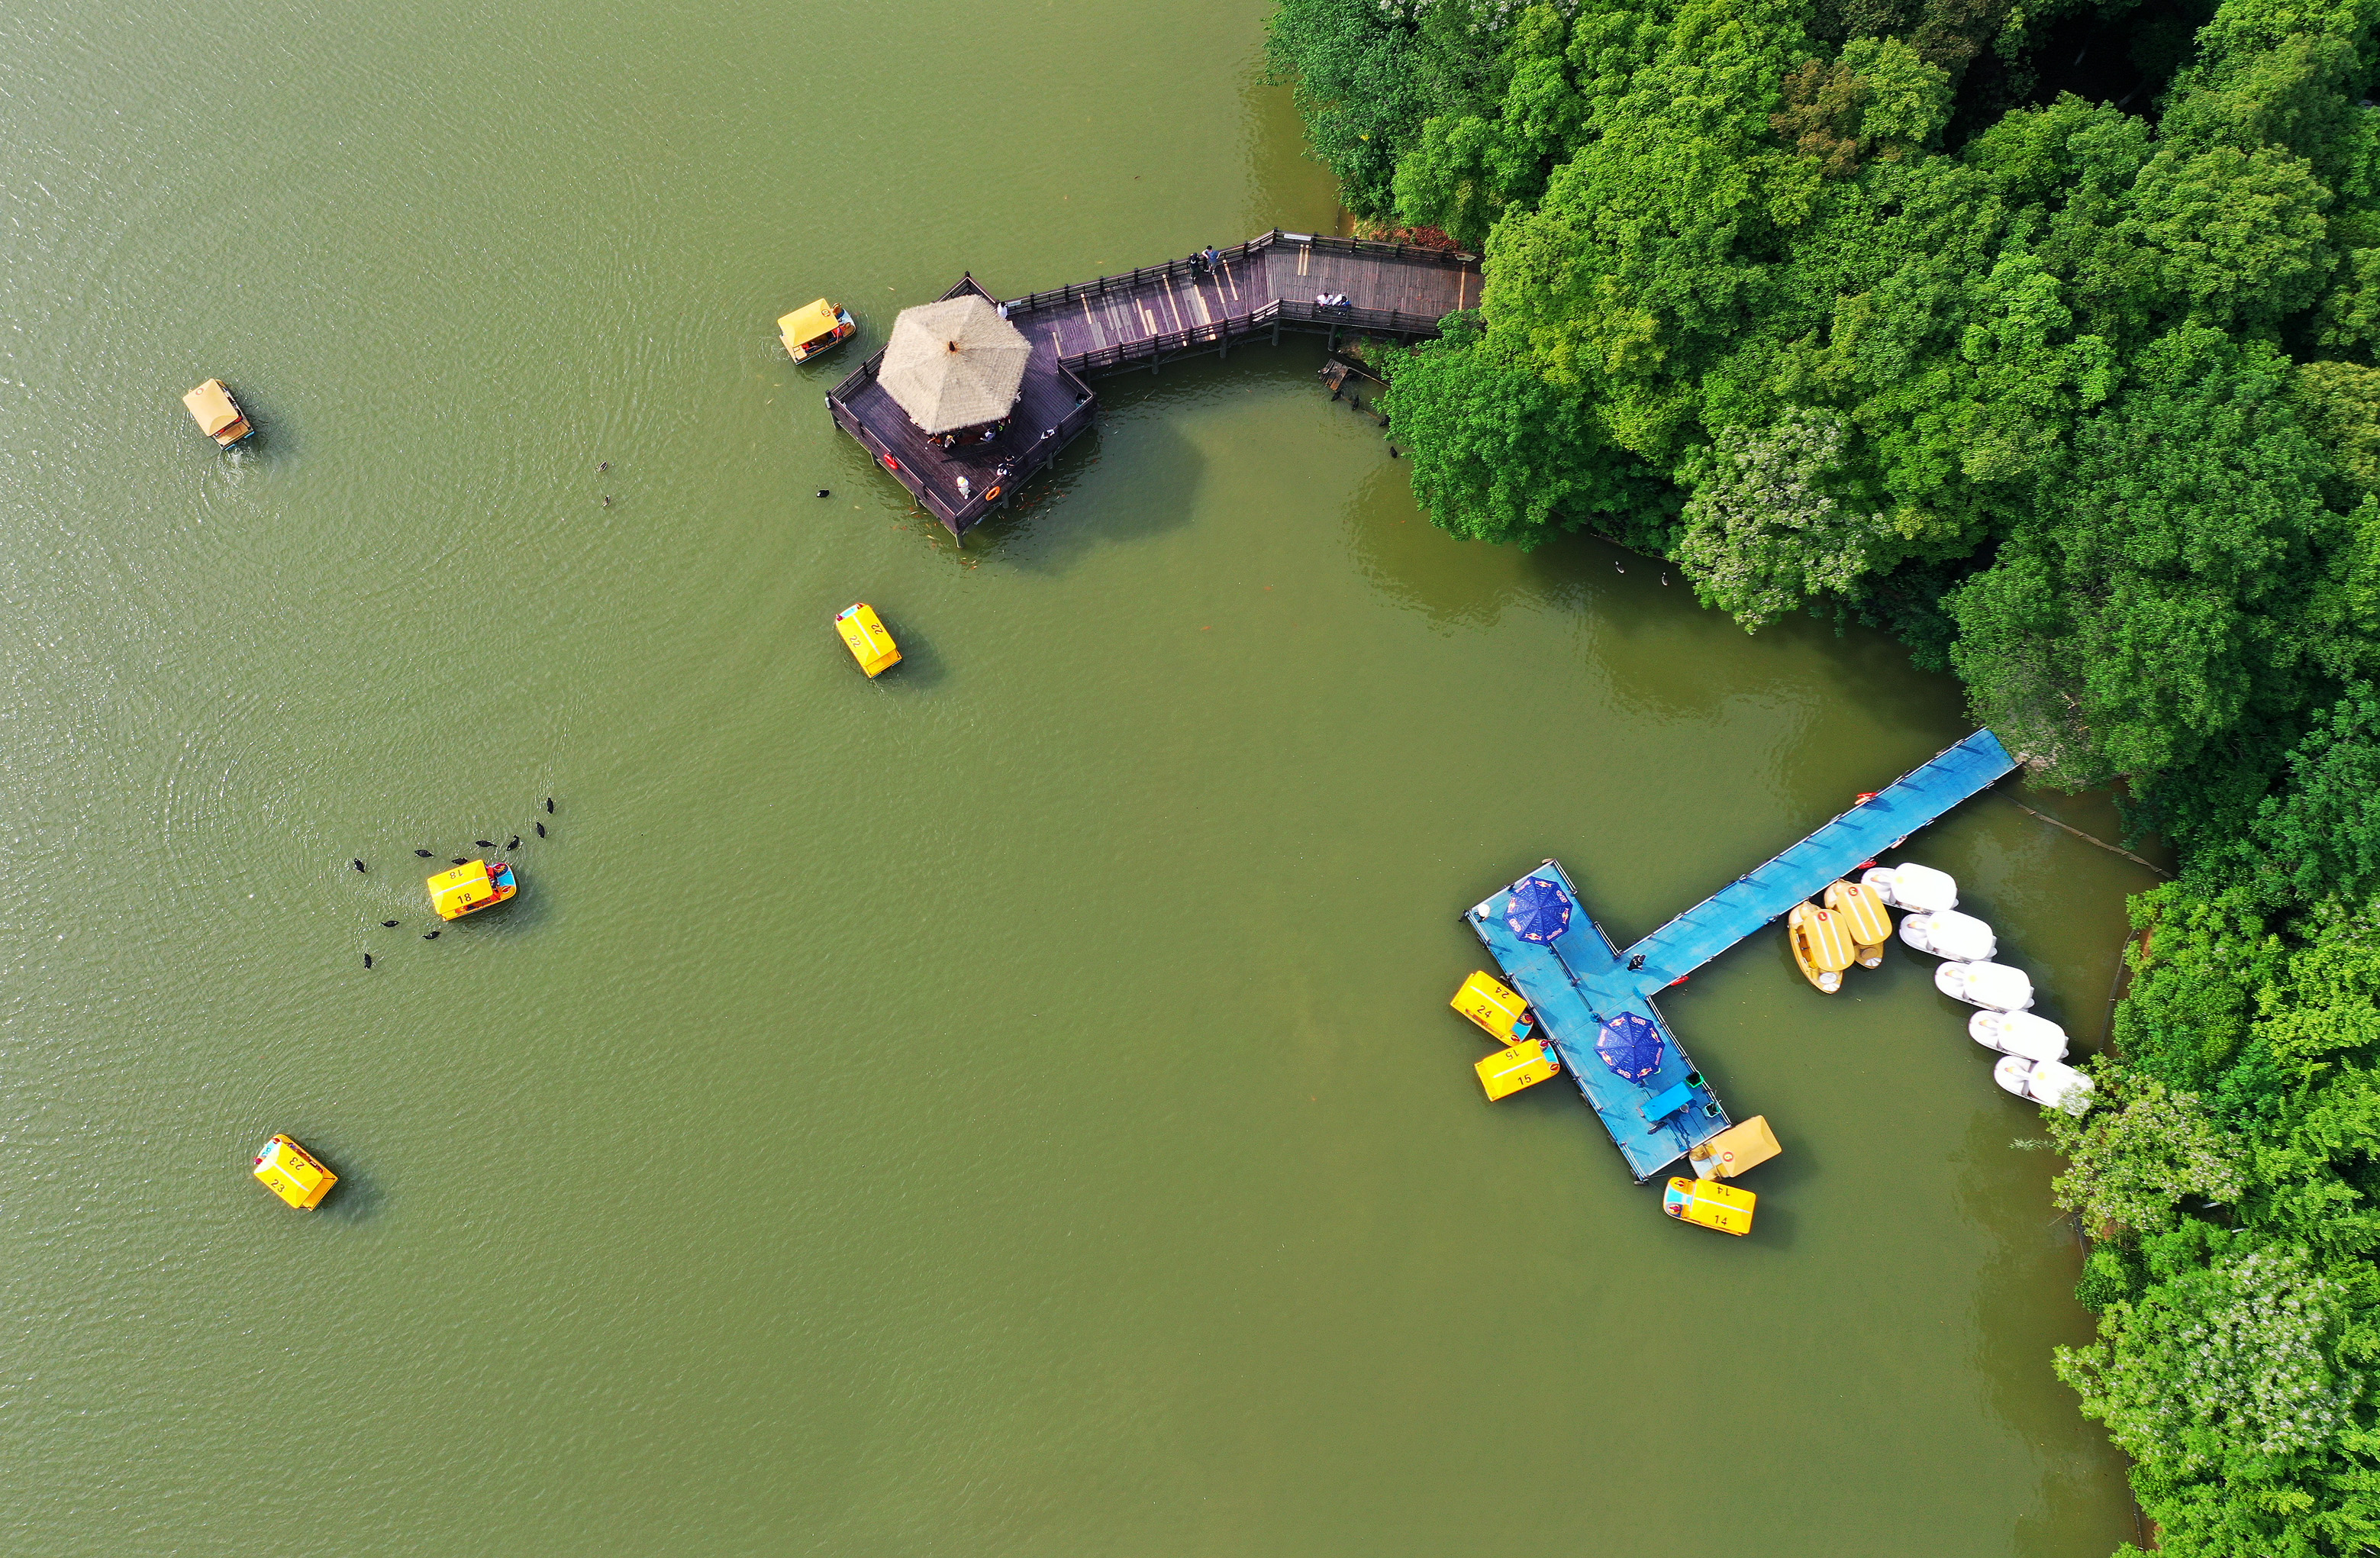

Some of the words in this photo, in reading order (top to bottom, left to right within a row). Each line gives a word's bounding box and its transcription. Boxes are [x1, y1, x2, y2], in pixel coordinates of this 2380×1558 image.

[871, 623, 883, 635] 22
[850, 635, 861, 648] 22
[450, 869, 463, 879] 18
[457, 893, 472, 904] 18
[1495, 986, 1510, 999] 24
[1477, 1005, 1492, 1018] 24
[1505, 1050, 1520, 1060] 15
[1517, 1074, 1532, 1085] 15
[289, 1157, 305, 1170] 23
[271, 1179, 285, 1192] 23
[1717, 1186, 1730, 1196] 14
[1714, 1214, 1727, 1226] 14
